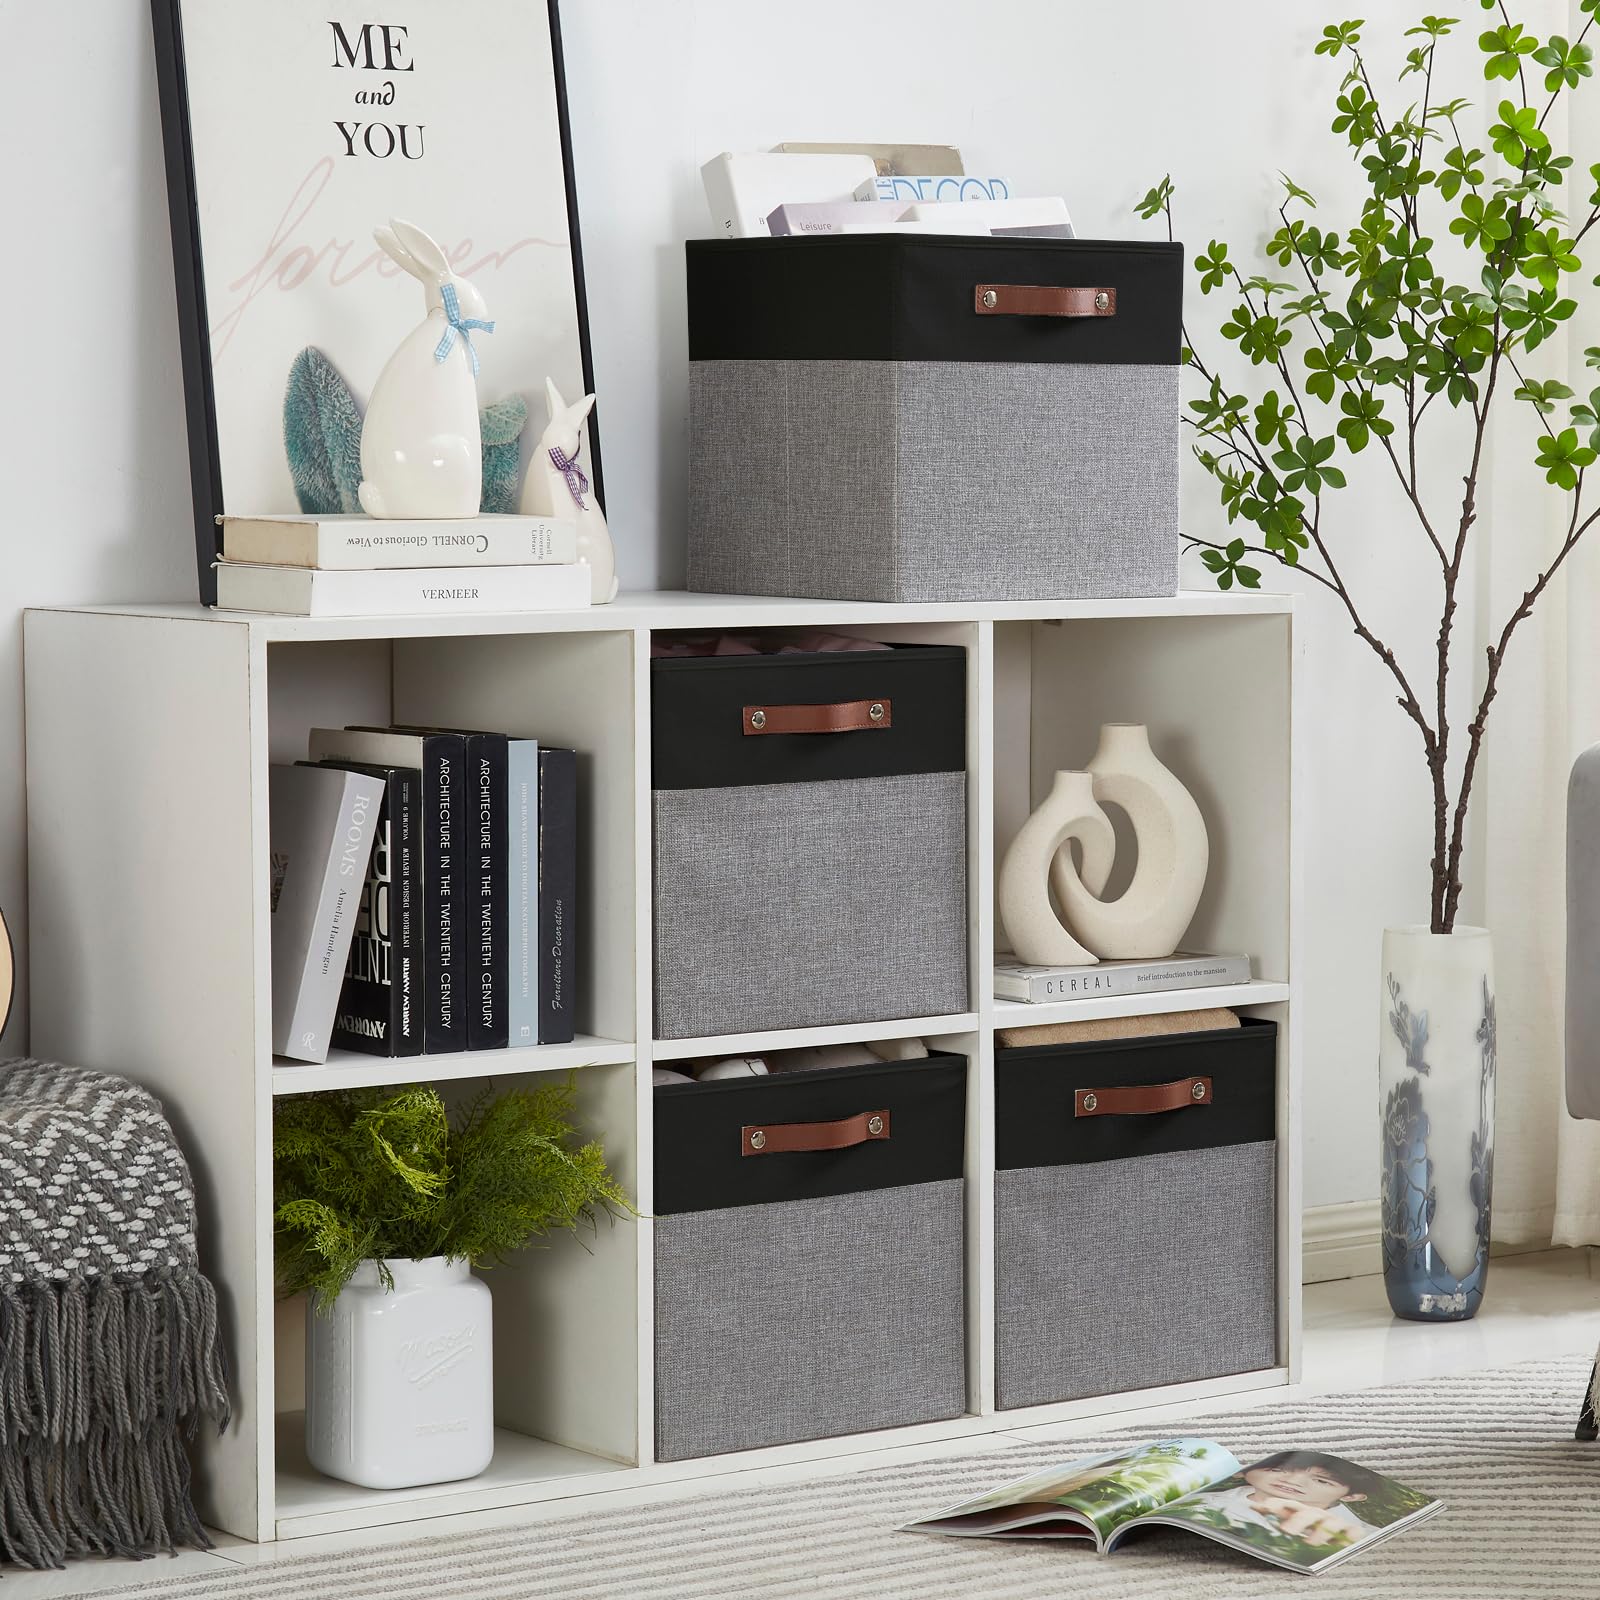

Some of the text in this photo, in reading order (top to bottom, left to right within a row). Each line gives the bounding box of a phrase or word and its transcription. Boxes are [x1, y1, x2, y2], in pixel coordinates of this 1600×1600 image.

[327, 21, 415, 72] ME
[354, 81, 396, 107] and
[333, 121, 426, 160] YOU
[799, 221, 832, 232] Leisure
[346, 533, 488, 553] CORNELL Glorious to View
[530, 529, 538, 555] Library
[545, 528, 554, 556] Cornell
[421, 588, 479, 600] VERMEER
[521, 860, 528, 871] TO
[322, 794, 370, 975] ROOMS Amelia Handegan
[439, 757, 451, 1029] ARCHITECTURE IN THE TWENTIETH CENTURY
[480, 758, 492, 1028] ARCHITECTURE IN THE TWENTIETH CENTURY
[552, 899, 562, 1010] Furniture Decoration
[1046, 967, 1227, 994] CEREAL Brief introduction to the mansion
[402, 957, 411, 1037] ANDREW MARTIN
[337, 1013, 387, 1039] ANDREW
